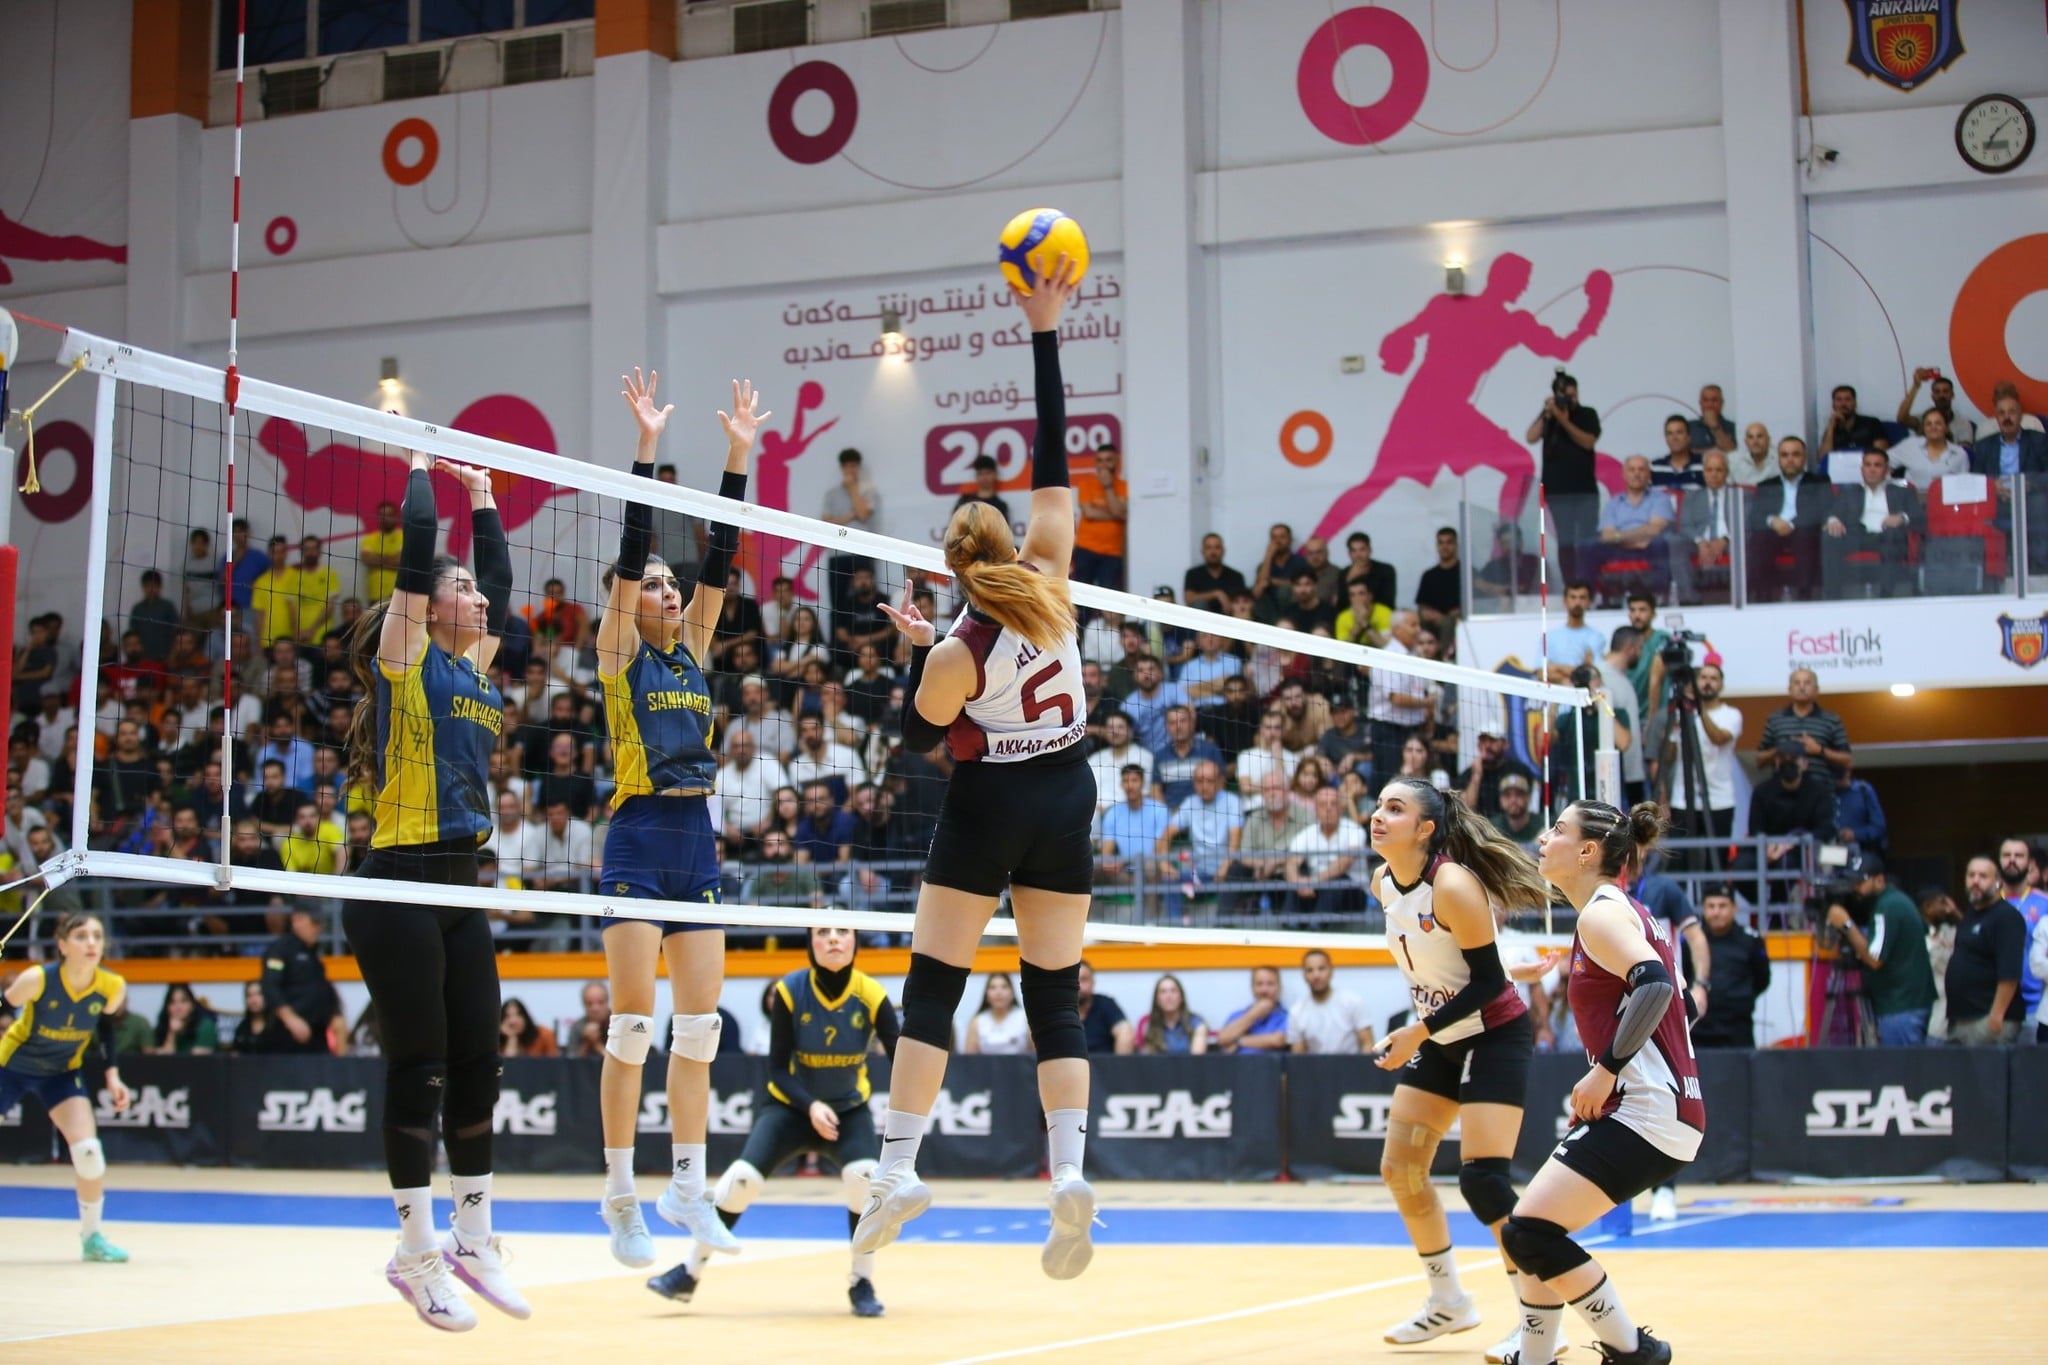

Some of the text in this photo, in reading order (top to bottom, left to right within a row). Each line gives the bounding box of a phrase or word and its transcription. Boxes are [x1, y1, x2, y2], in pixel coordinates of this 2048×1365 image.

[1869, 0, 1940, 17] ANKAWA
[1020, 659, 1075, 728] 5
[1399, 934, 1415, 972] 1
[257, 1088, 367, 1132] STAG
[1098, 1090, 1232, 1138] STAG
[1806, 1085, 1953, 1136] STAG
